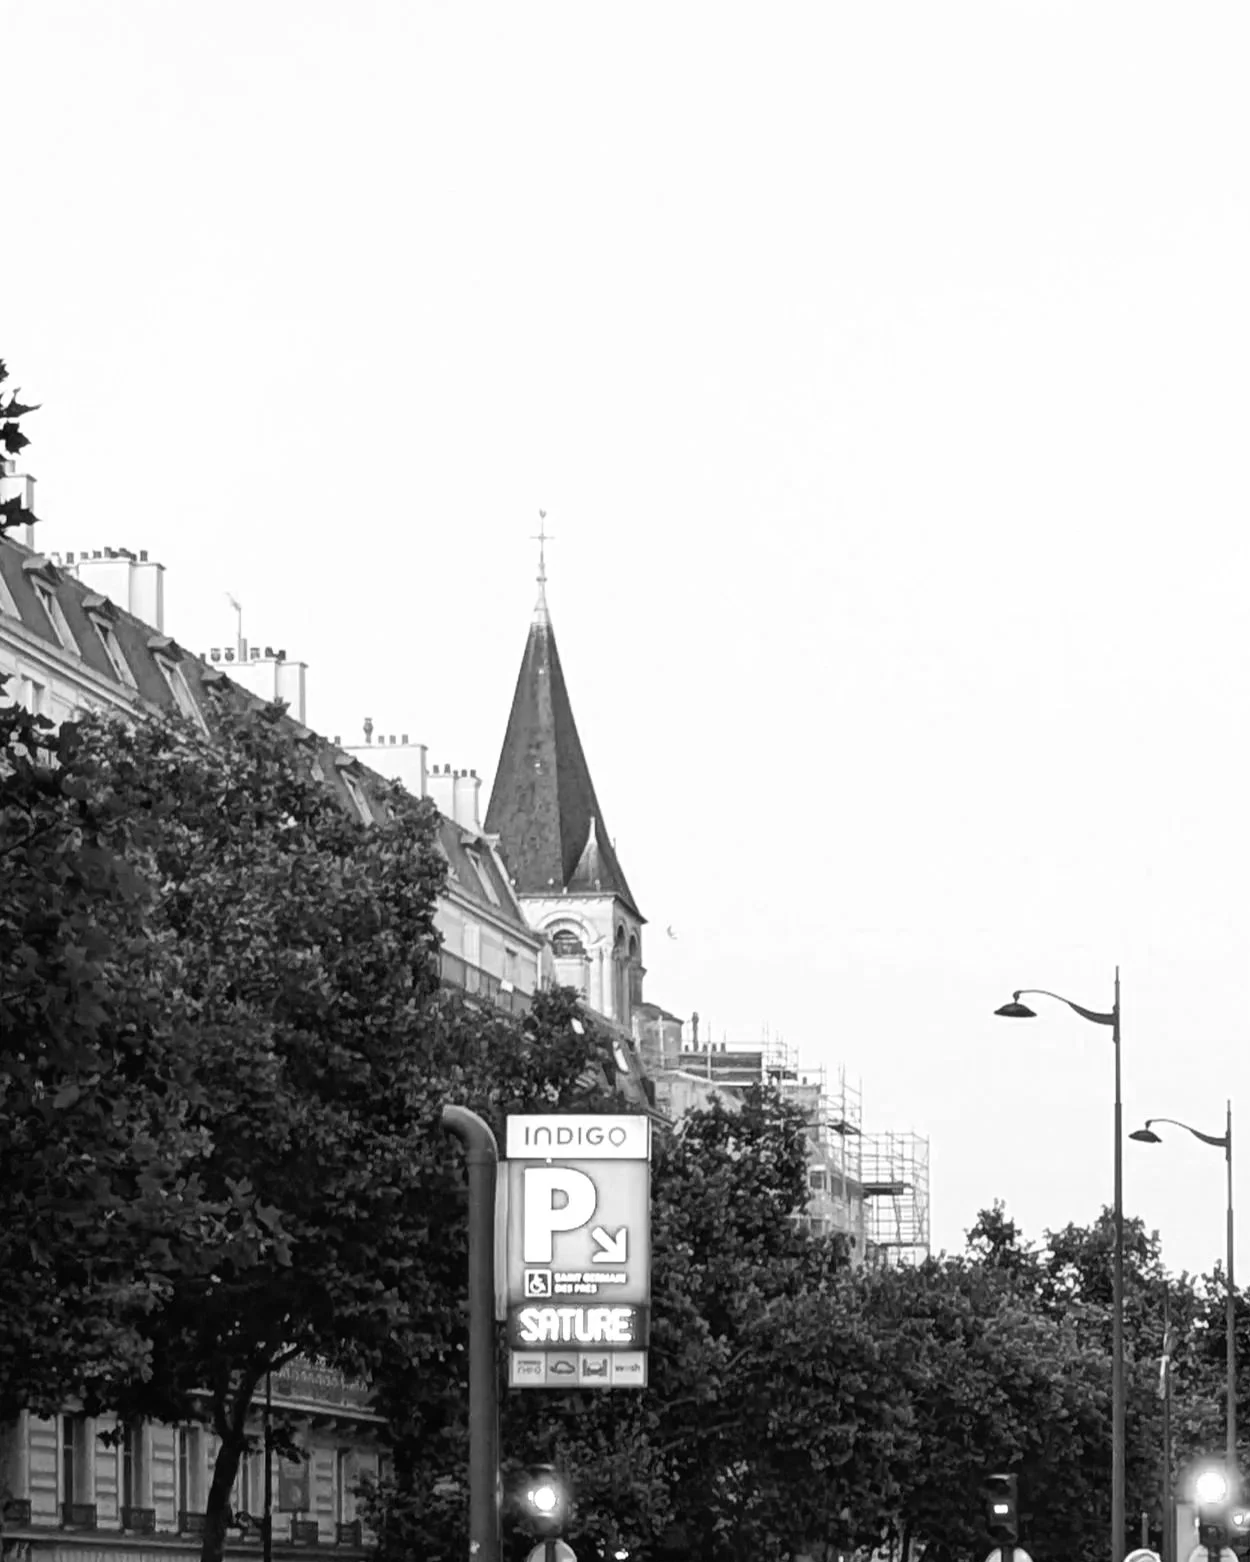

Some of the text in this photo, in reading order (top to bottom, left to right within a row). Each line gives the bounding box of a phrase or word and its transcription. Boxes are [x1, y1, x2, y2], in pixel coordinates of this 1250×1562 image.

[524, 1126, 627, 1147] INDIGO
[523, 1166, 597, 1264] P
[520, 1307, 633, 1342] SATURE
